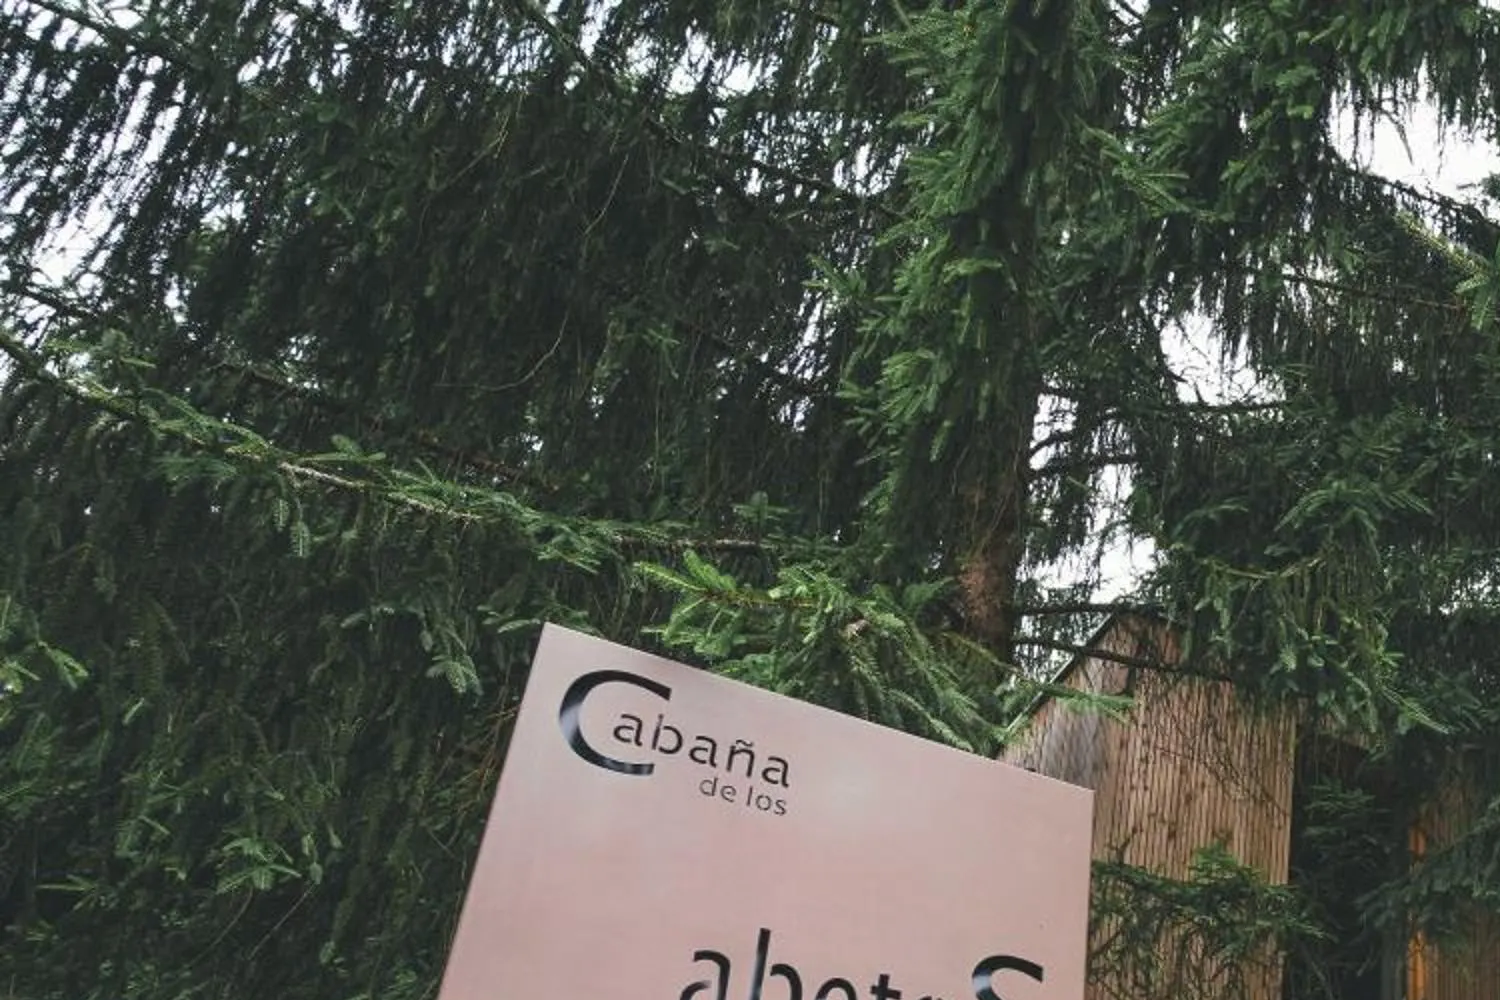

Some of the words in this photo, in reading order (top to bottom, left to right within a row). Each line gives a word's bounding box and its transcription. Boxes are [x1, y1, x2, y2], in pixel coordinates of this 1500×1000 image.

[558, 669, 790, 788] Cabaña
[700, 777, 737, 803] de
[746, 786, 787, 816] los
